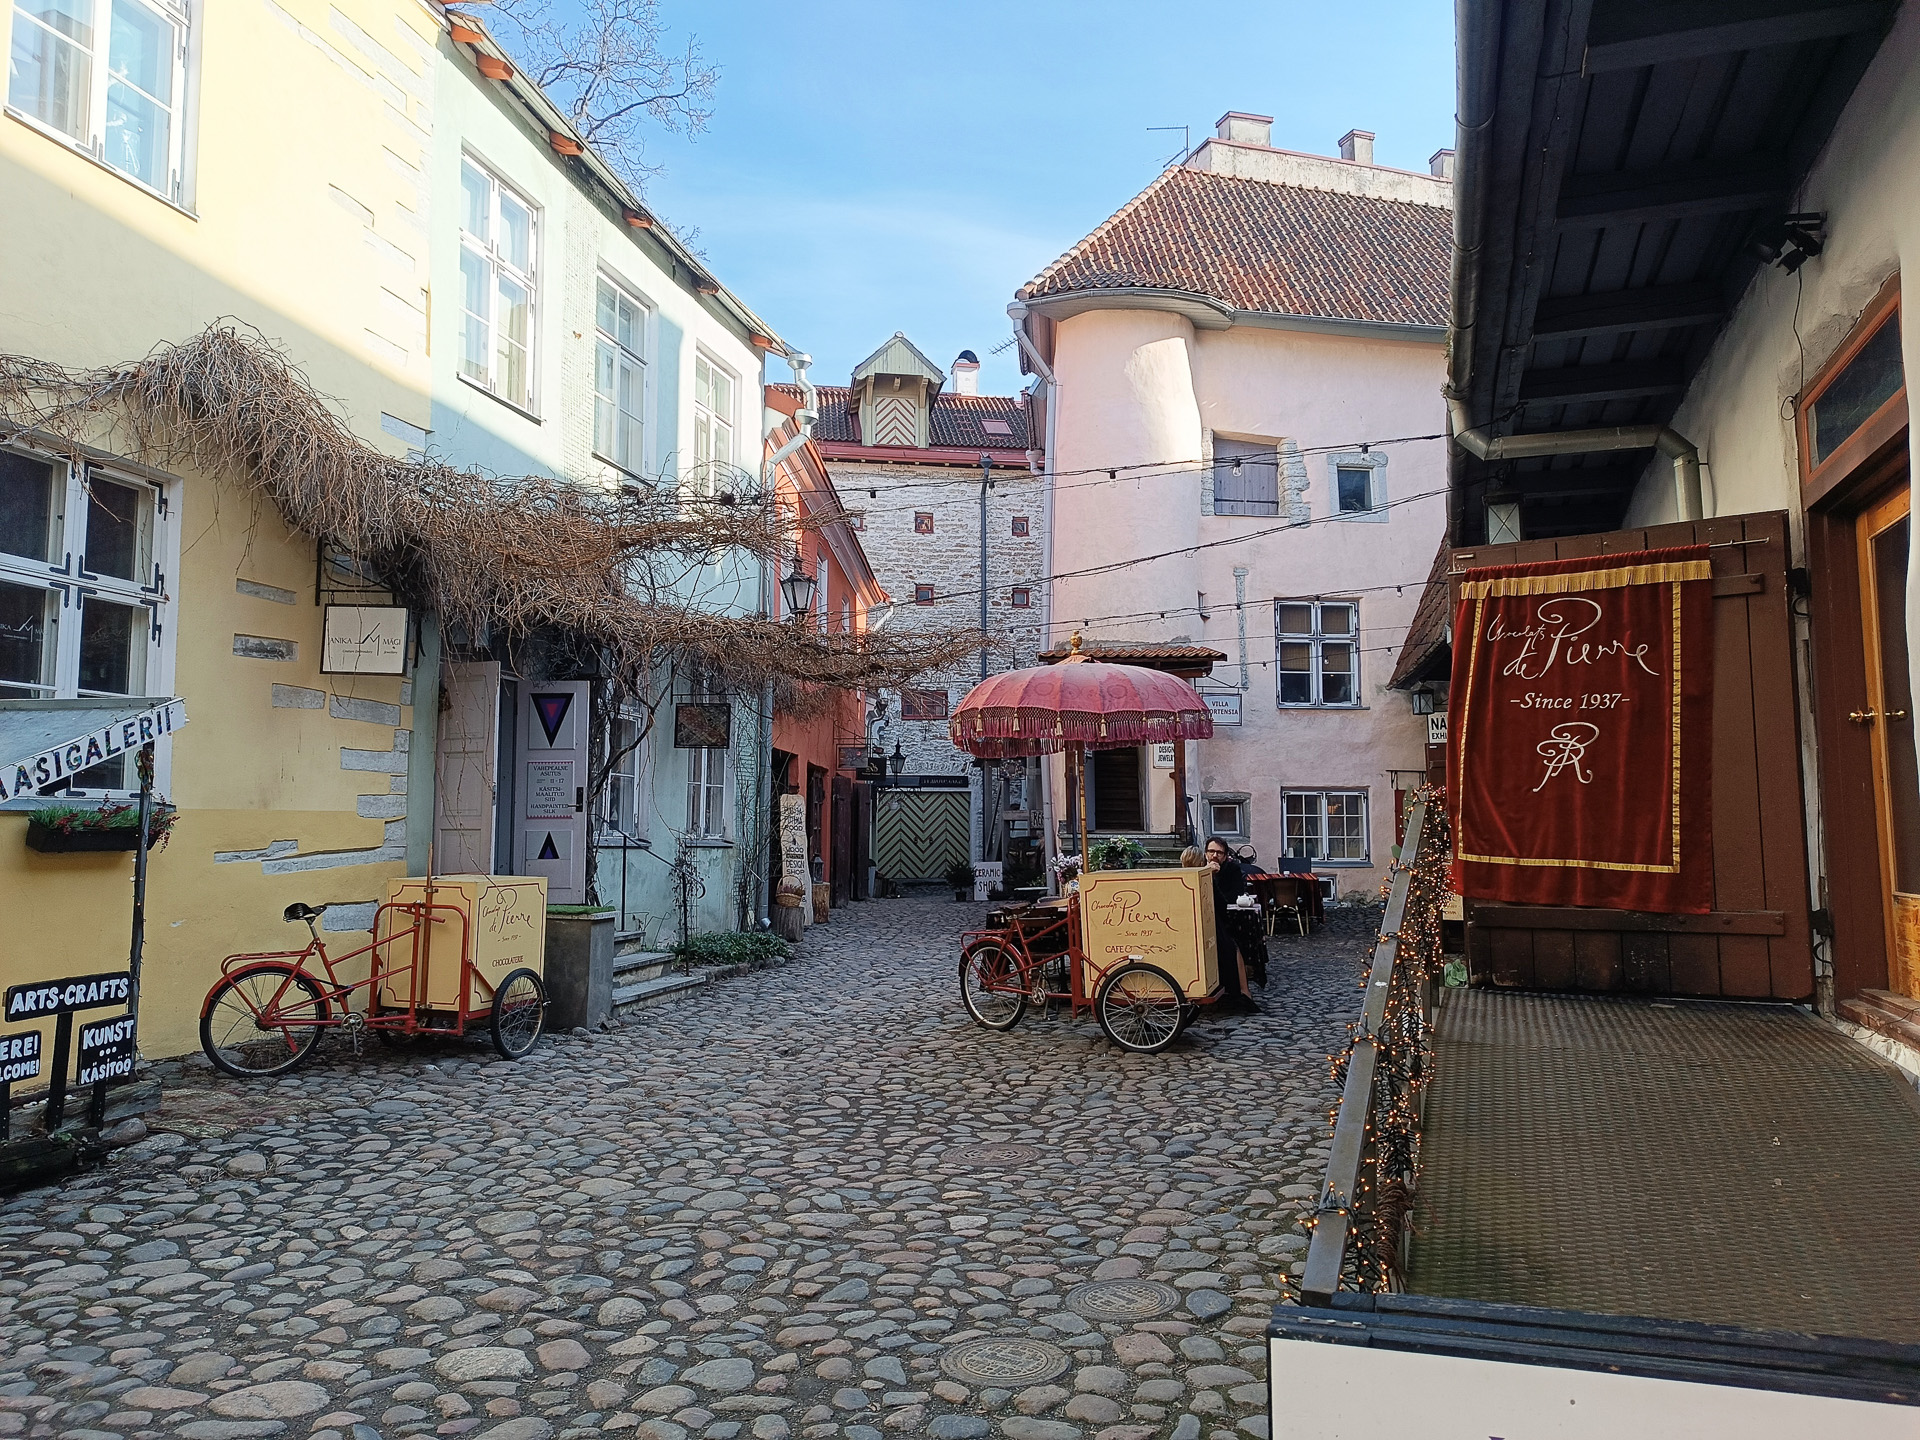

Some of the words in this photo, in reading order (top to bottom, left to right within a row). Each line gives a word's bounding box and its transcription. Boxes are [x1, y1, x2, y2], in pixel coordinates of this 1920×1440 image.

[330, 637, 353, 645] ANIKA
[1503, 637, 1539, 680] de
[1537, 597, 1660, 678] Pierre
[1211, 700, 1229, 708] VILLA
[1210, 708, 1239, 716] ORTENSIA
[1430, 714, 1448, 731] NÄ
[1157, 754, 1174, 762] JEWELR
[785, 859, 805, 869] DESIGN
[974, 868, 1001, 878] CERAMIC
[978, 880, 998, 893] SHOP
[496, 887, 535, 935] Pierre
[1102, 911, 1116, 926] de
[1112, 889, 1179, 933] Pierre
[1140, 929, 1154, 937] 1937
[82, 1019, 135, 1050] KUNST
[80, 1053, 132, 1085] KÄSITÖÖ
